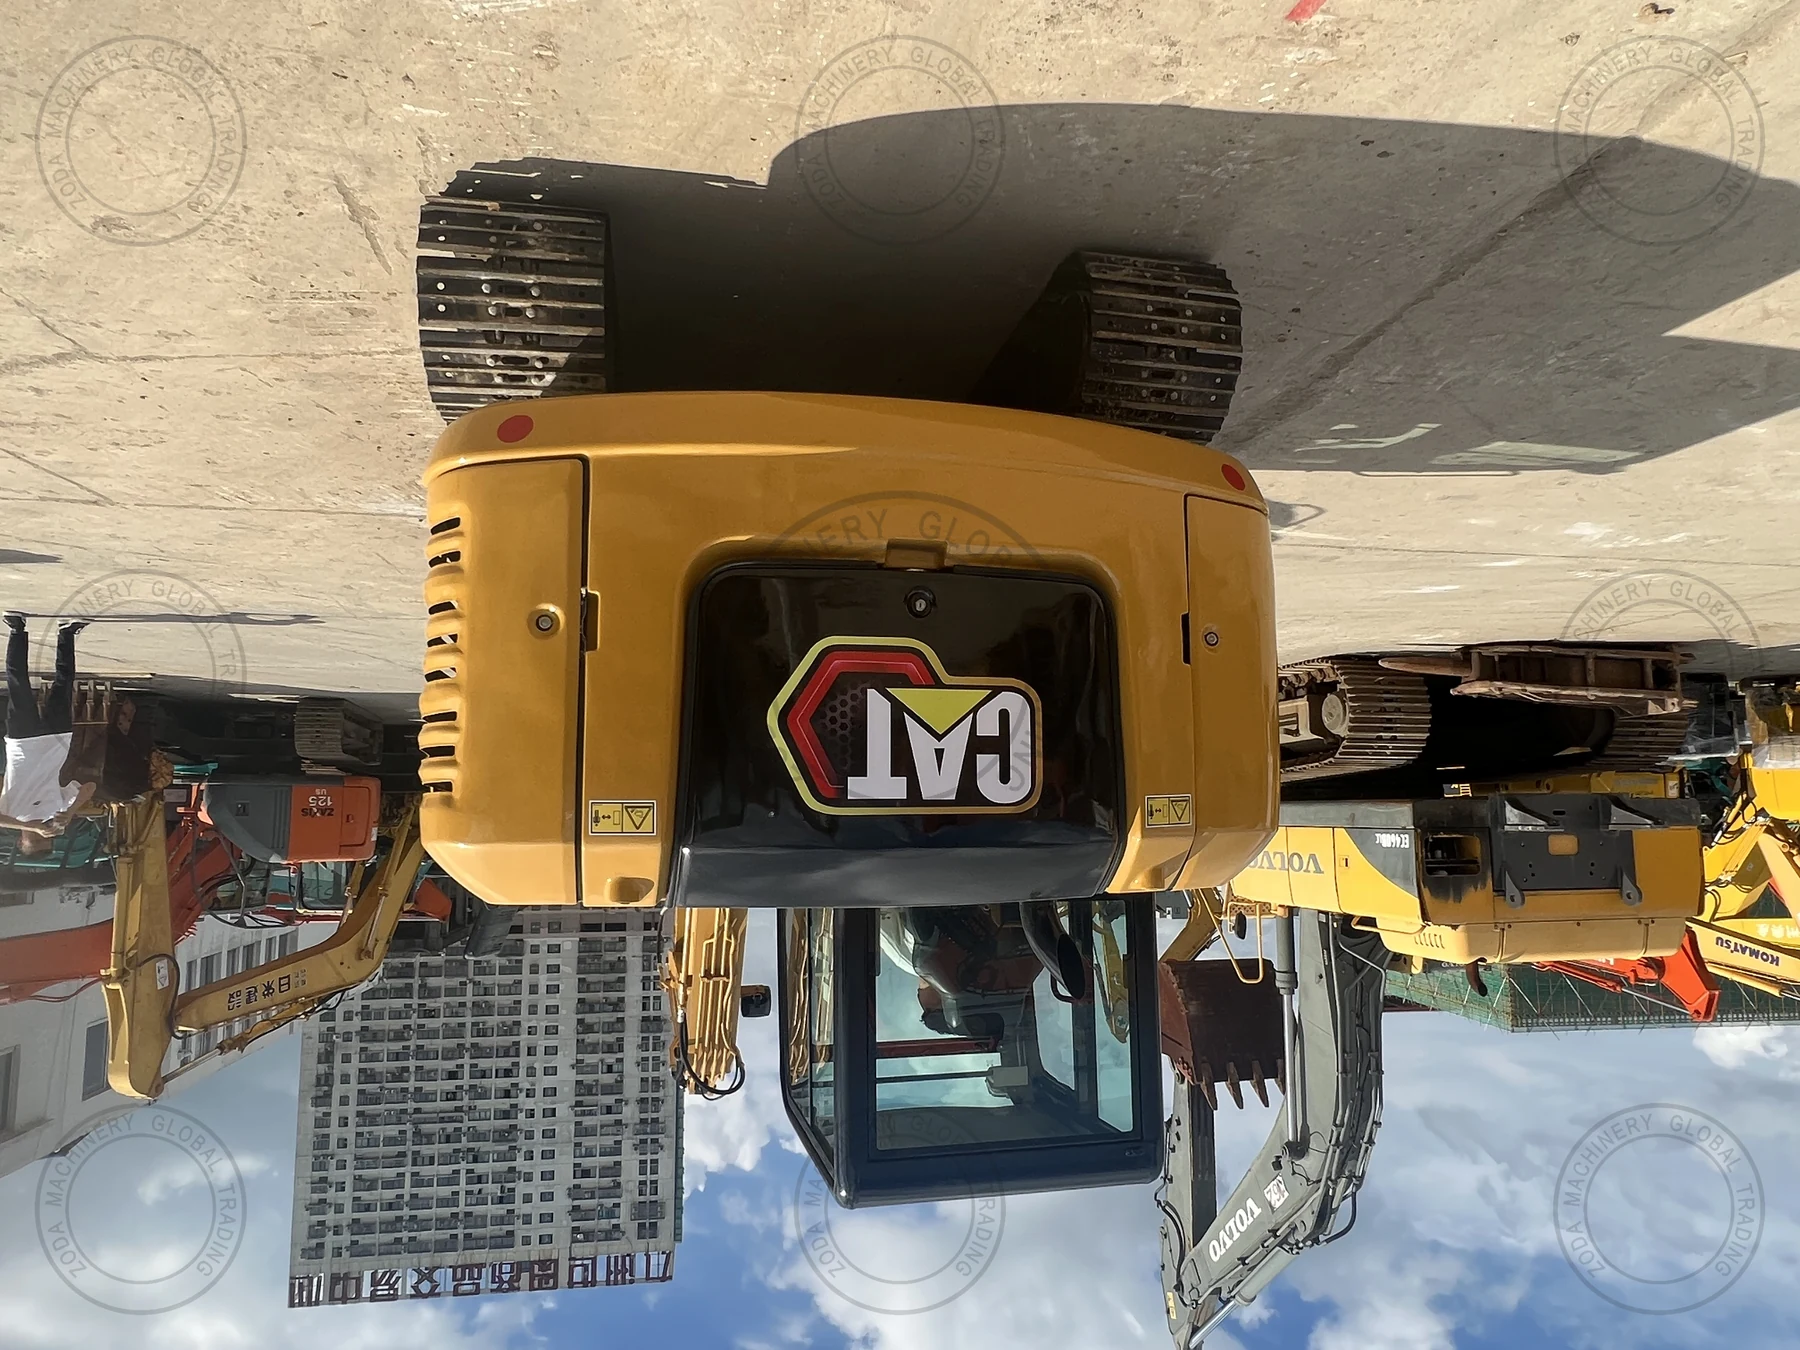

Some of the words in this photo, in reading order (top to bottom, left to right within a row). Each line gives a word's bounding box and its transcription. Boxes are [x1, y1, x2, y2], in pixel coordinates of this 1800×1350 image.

[847, 688, 1031, 804] CAT
[300, 807, 335, 817] ZAXIS
[308, 796, 333, 807] 125
[1714, 936, 1780, 967] KOMATSU
[1208, 1196, 1262, 1263] VOLVO
